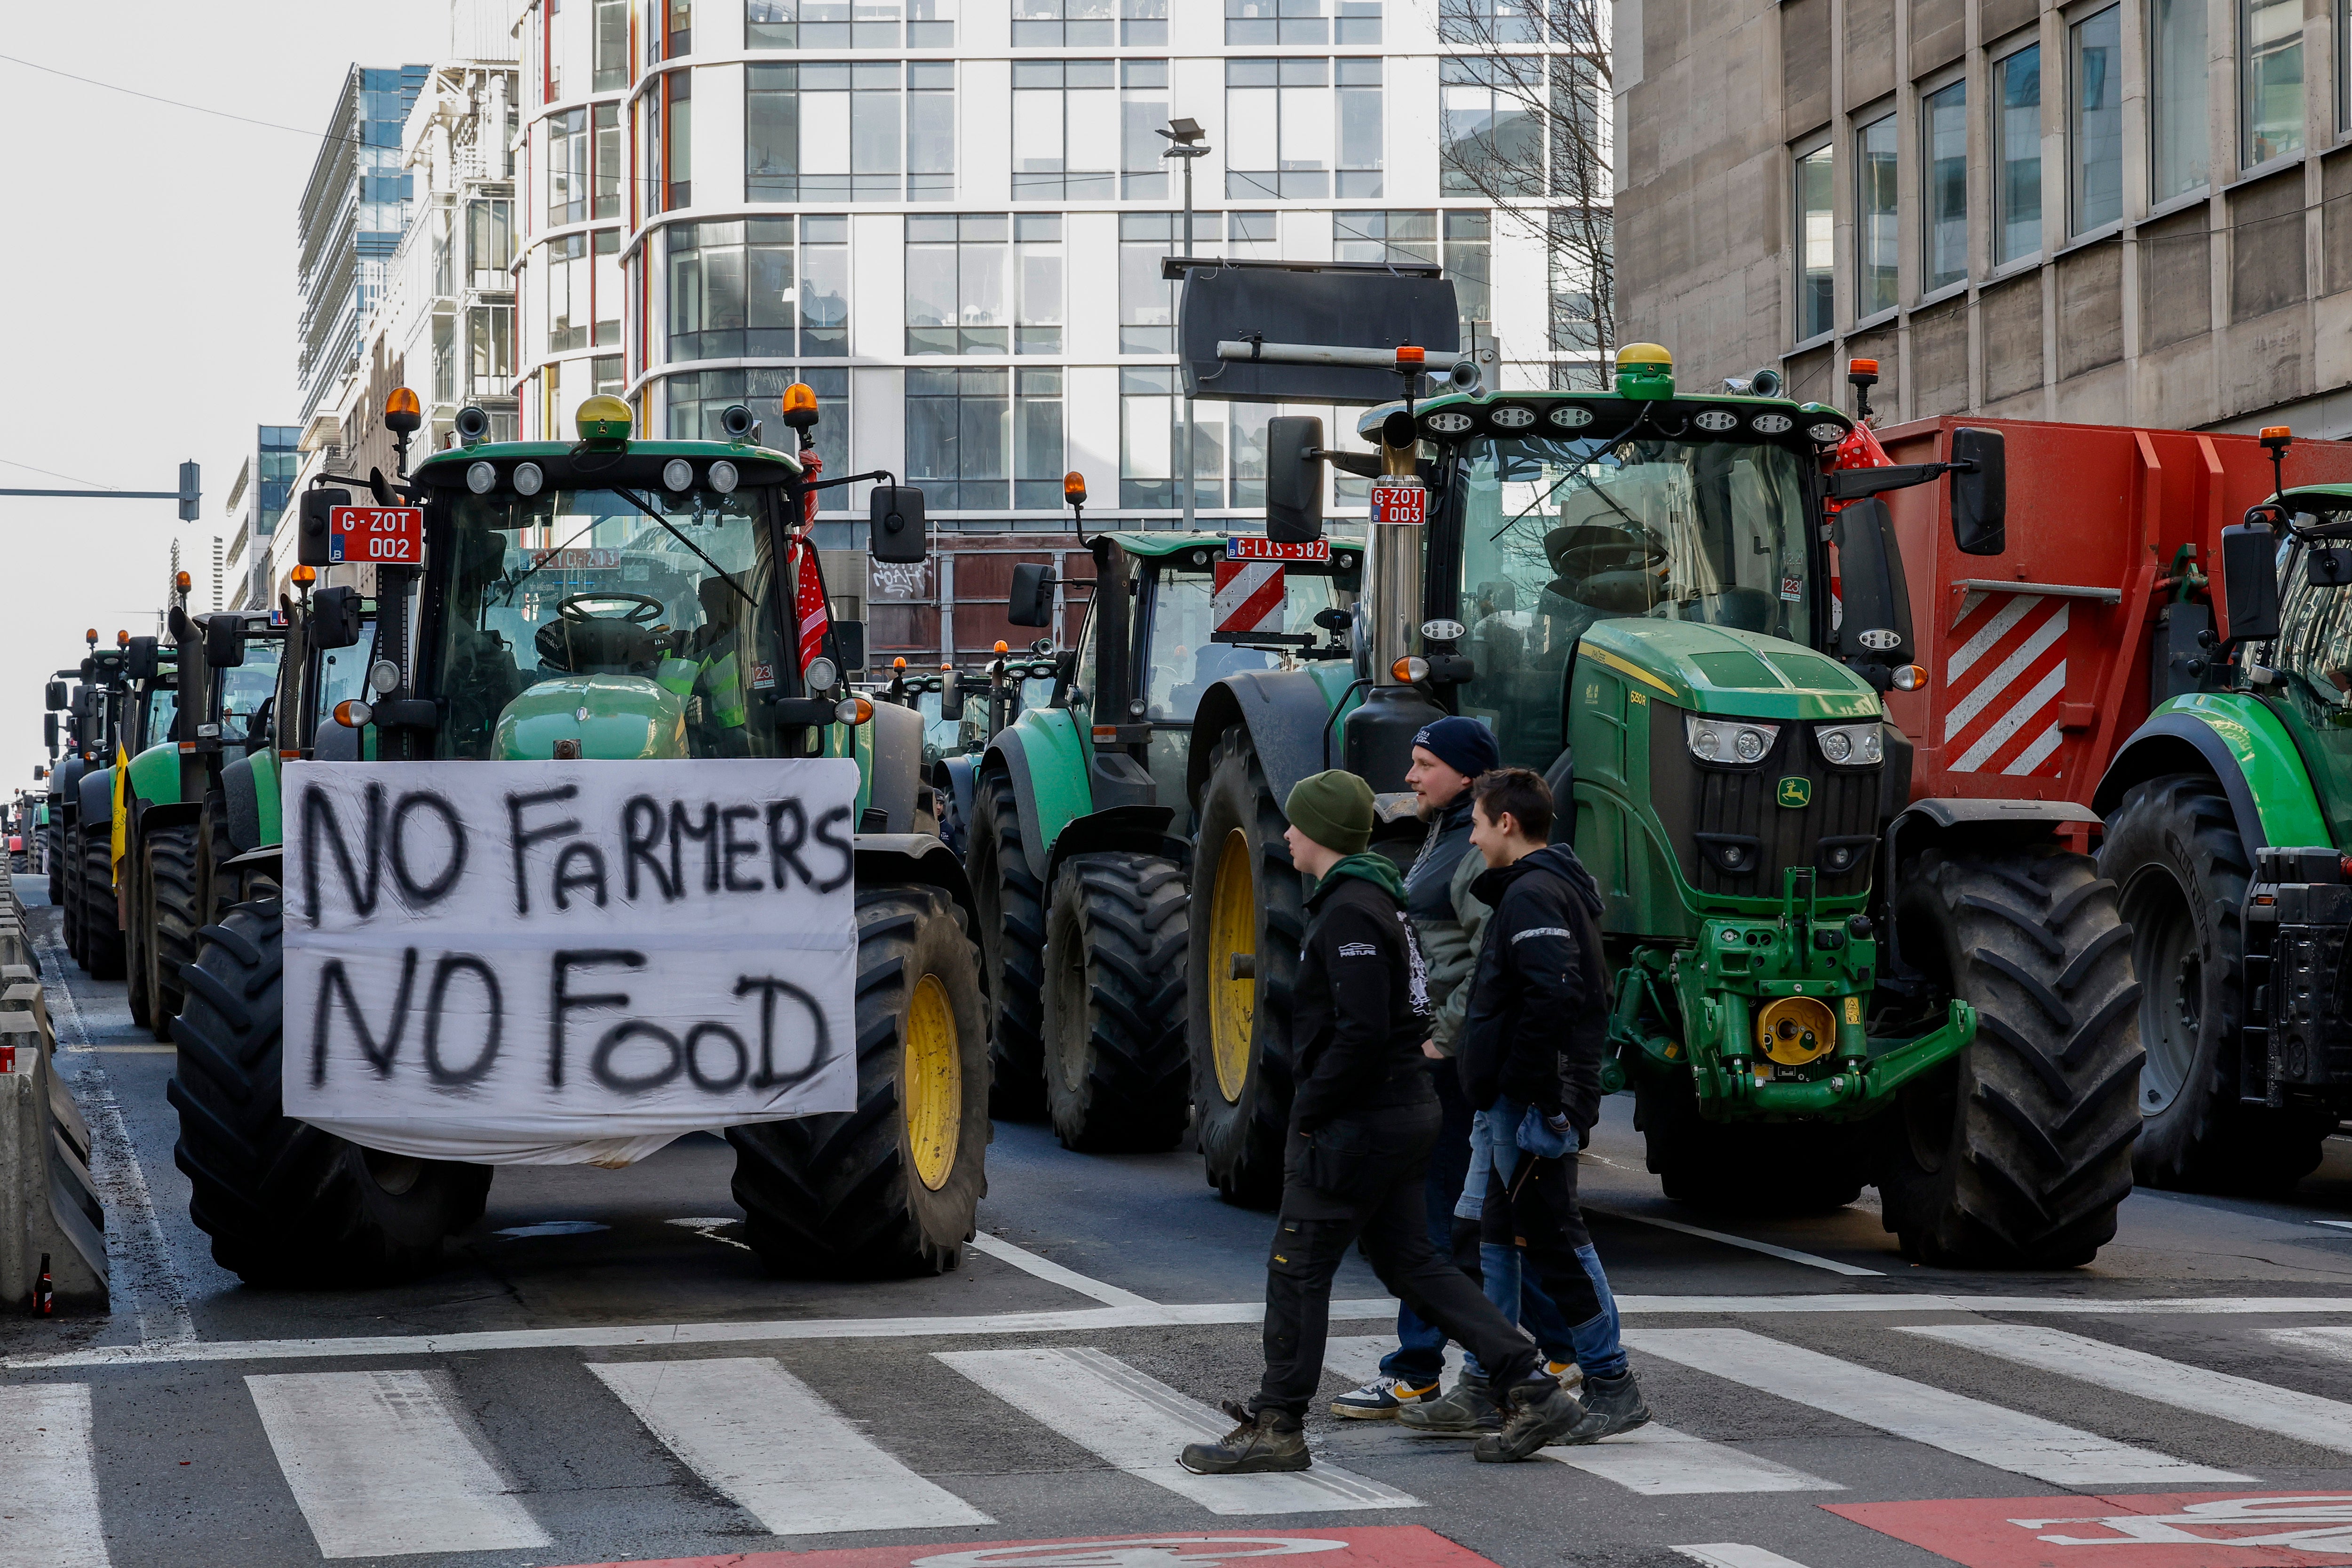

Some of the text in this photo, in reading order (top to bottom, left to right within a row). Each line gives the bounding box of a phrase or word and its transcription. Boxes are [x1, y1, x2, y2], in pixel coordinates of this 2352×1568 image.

[1374, 489, 1421, 504] G-ZOT
[342, 511, 410, 533] G-ZOT
[1389, 507, 1421, 522] 003
[333, 538, 410, 560] B 002
[1237, 539, 1325, 558] G-LXS-582
[1785, 579, 1799, 592] 23
[755, 666, 771, 679] 23
[1630, 690, 1646, 707] 6250R
[302, 780, 854, 928] NO FARMERS
[311, 946, 504, 1088] NO
